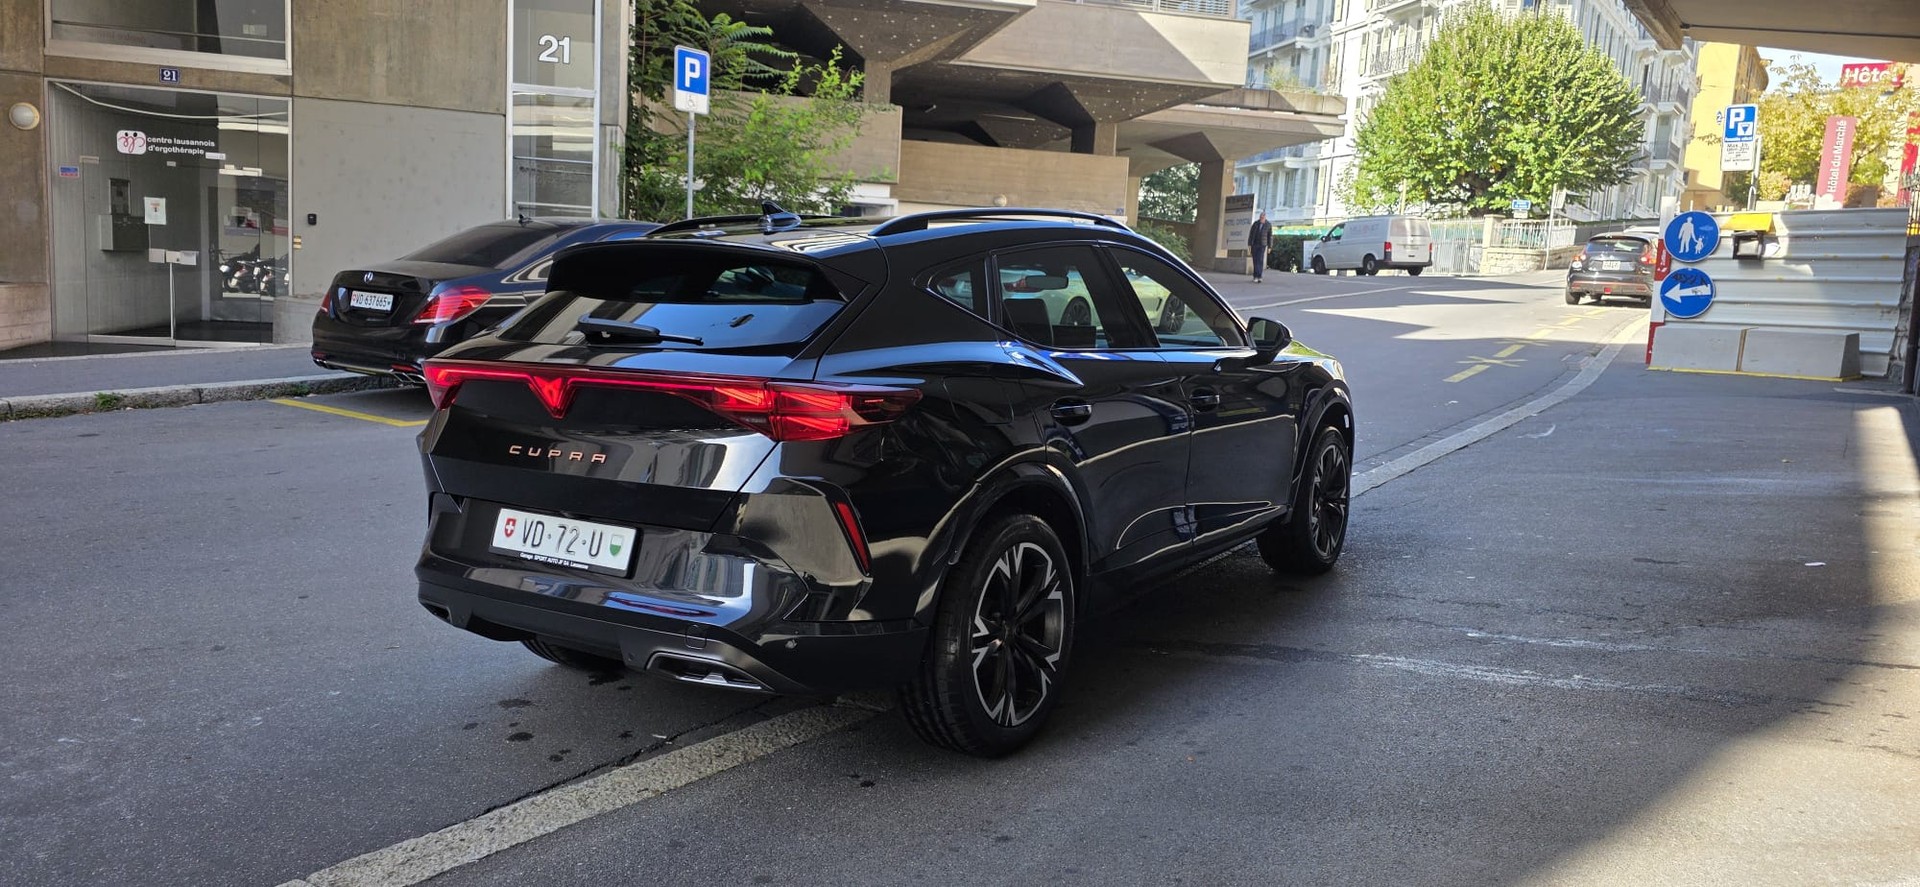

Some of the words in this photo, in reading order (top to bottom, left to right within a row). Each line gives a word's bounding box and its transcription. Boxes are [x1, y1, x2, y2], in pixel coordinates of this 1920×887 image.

[537, 34, 571, 64] 21
[163, 69, 176, 81] 21
[685, 57, 701, 88] P
[1729, 108, 1745, 129] P
[147, 136, 172, 144] centre
[173, 138, 215, 147] lausannois
[1833, 119, 1847, 154] Marché
[148, 145, 204, 155] d'ergothérapie
[1831, 155, 1841, 168] du
[1827, 168, 1840, 193] Hôtel
[356, 293, 364, 305] VD
[509, 445, 607, 464] CUPRA
